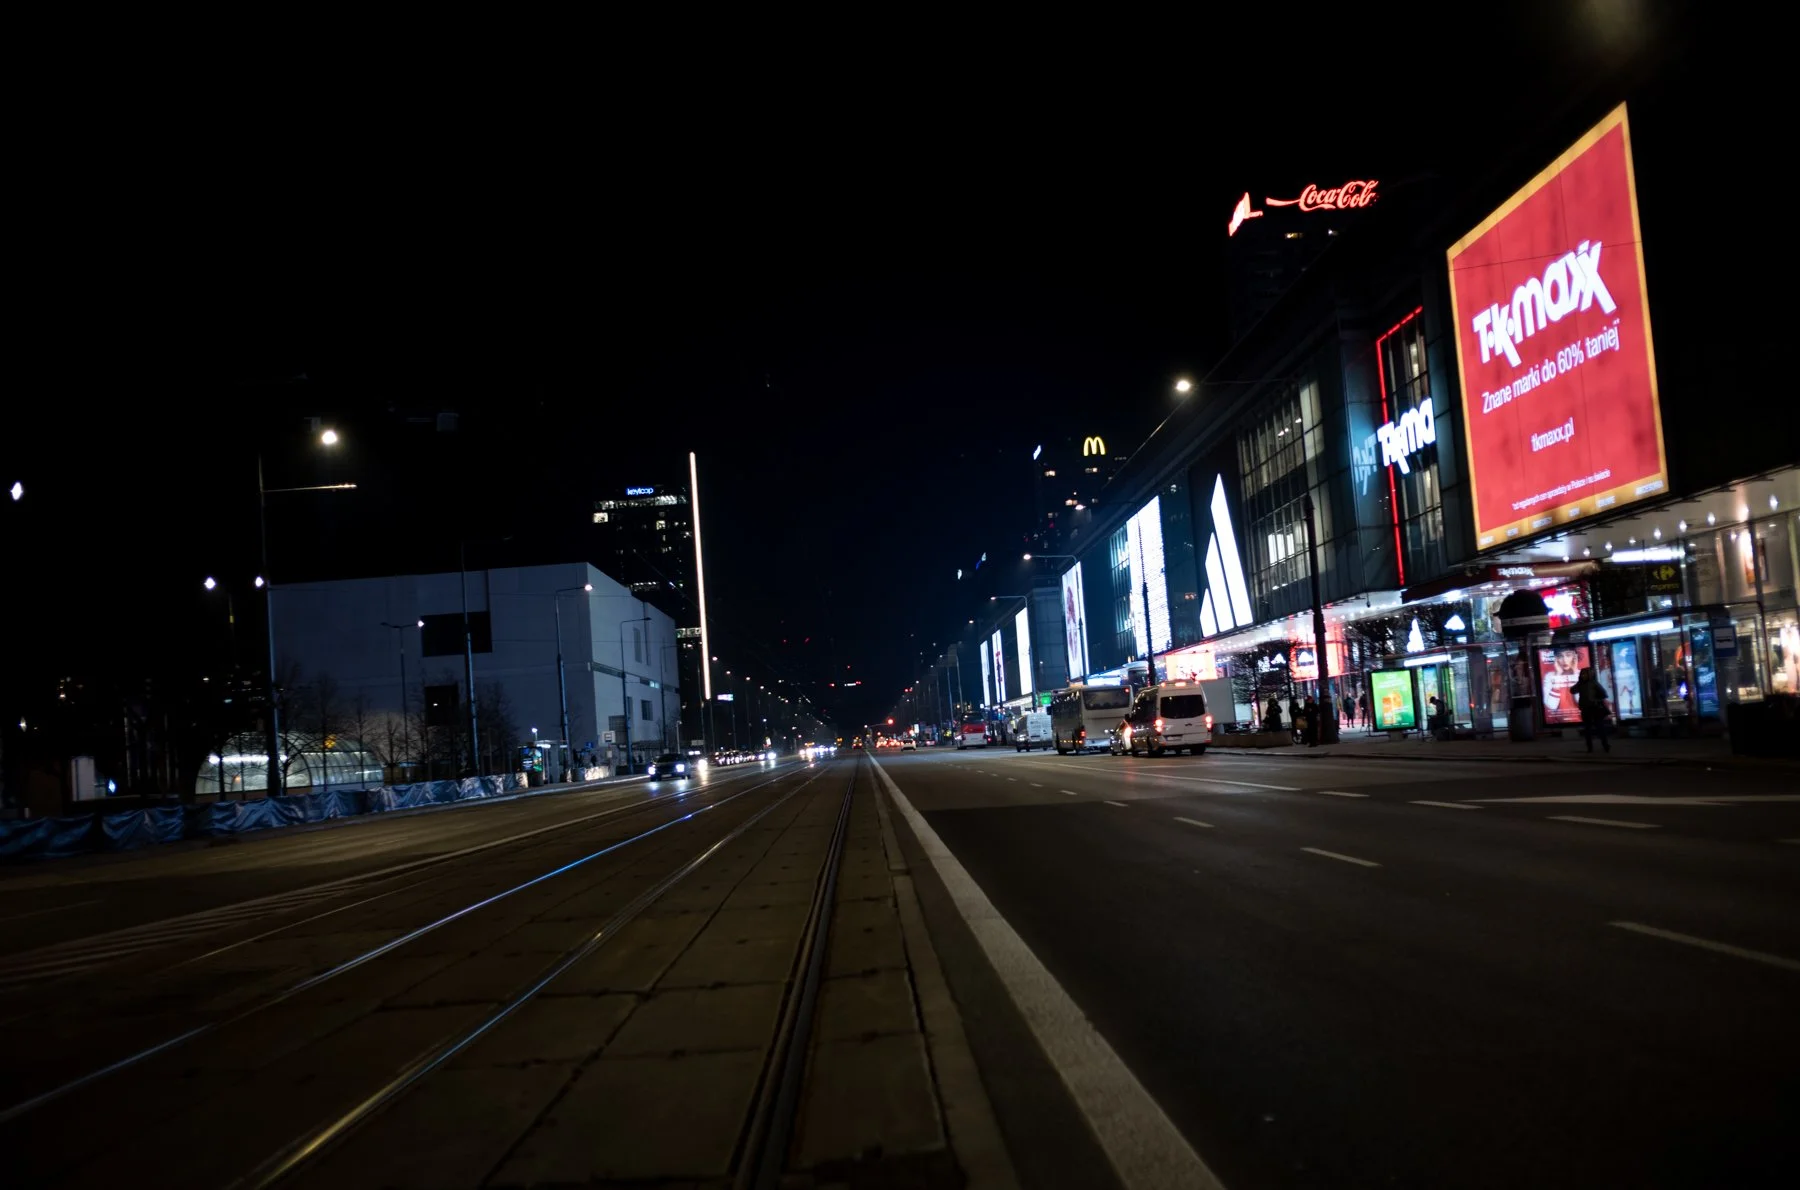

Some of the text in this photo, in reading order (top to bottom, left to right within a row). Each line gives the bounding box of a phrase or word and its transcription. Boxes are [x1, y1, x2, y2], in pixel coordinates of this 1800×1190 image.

[1482, 387, 1512, 414] Znane
[1513, 364, 1540, 398] marki
[1541, 358, 1557, 383] do
[1556, 340, 1585, 374] 60%
[1531, 417, 1575, 452] tkmaxx.pl
[627, 487, 654, 496] keyloop
